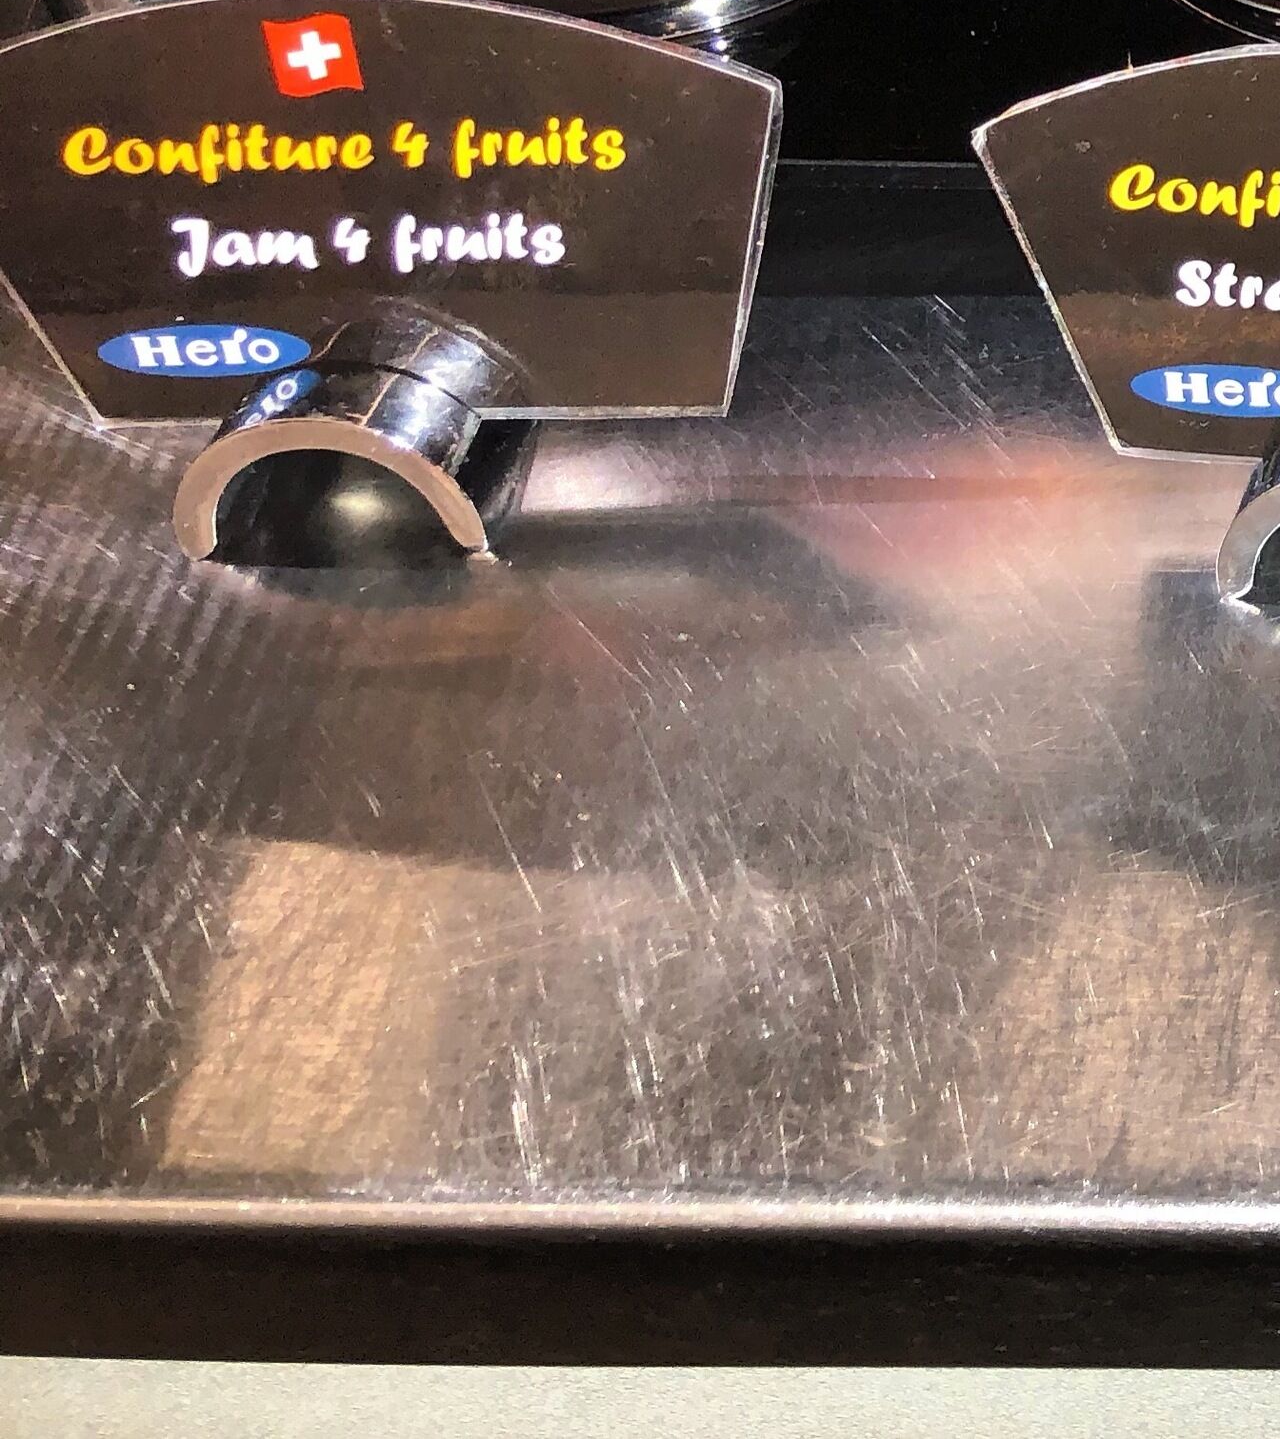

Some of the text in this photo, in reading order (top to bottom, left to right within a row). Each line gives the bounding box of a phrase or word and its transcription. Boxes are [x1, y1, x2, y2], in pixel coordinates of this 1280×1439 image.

[63, 116, 627, 184] Confiture 4 fruits
[171, 212, 566, 278] Jam 4 fruits
[130, 328, 280, 368] Hero
